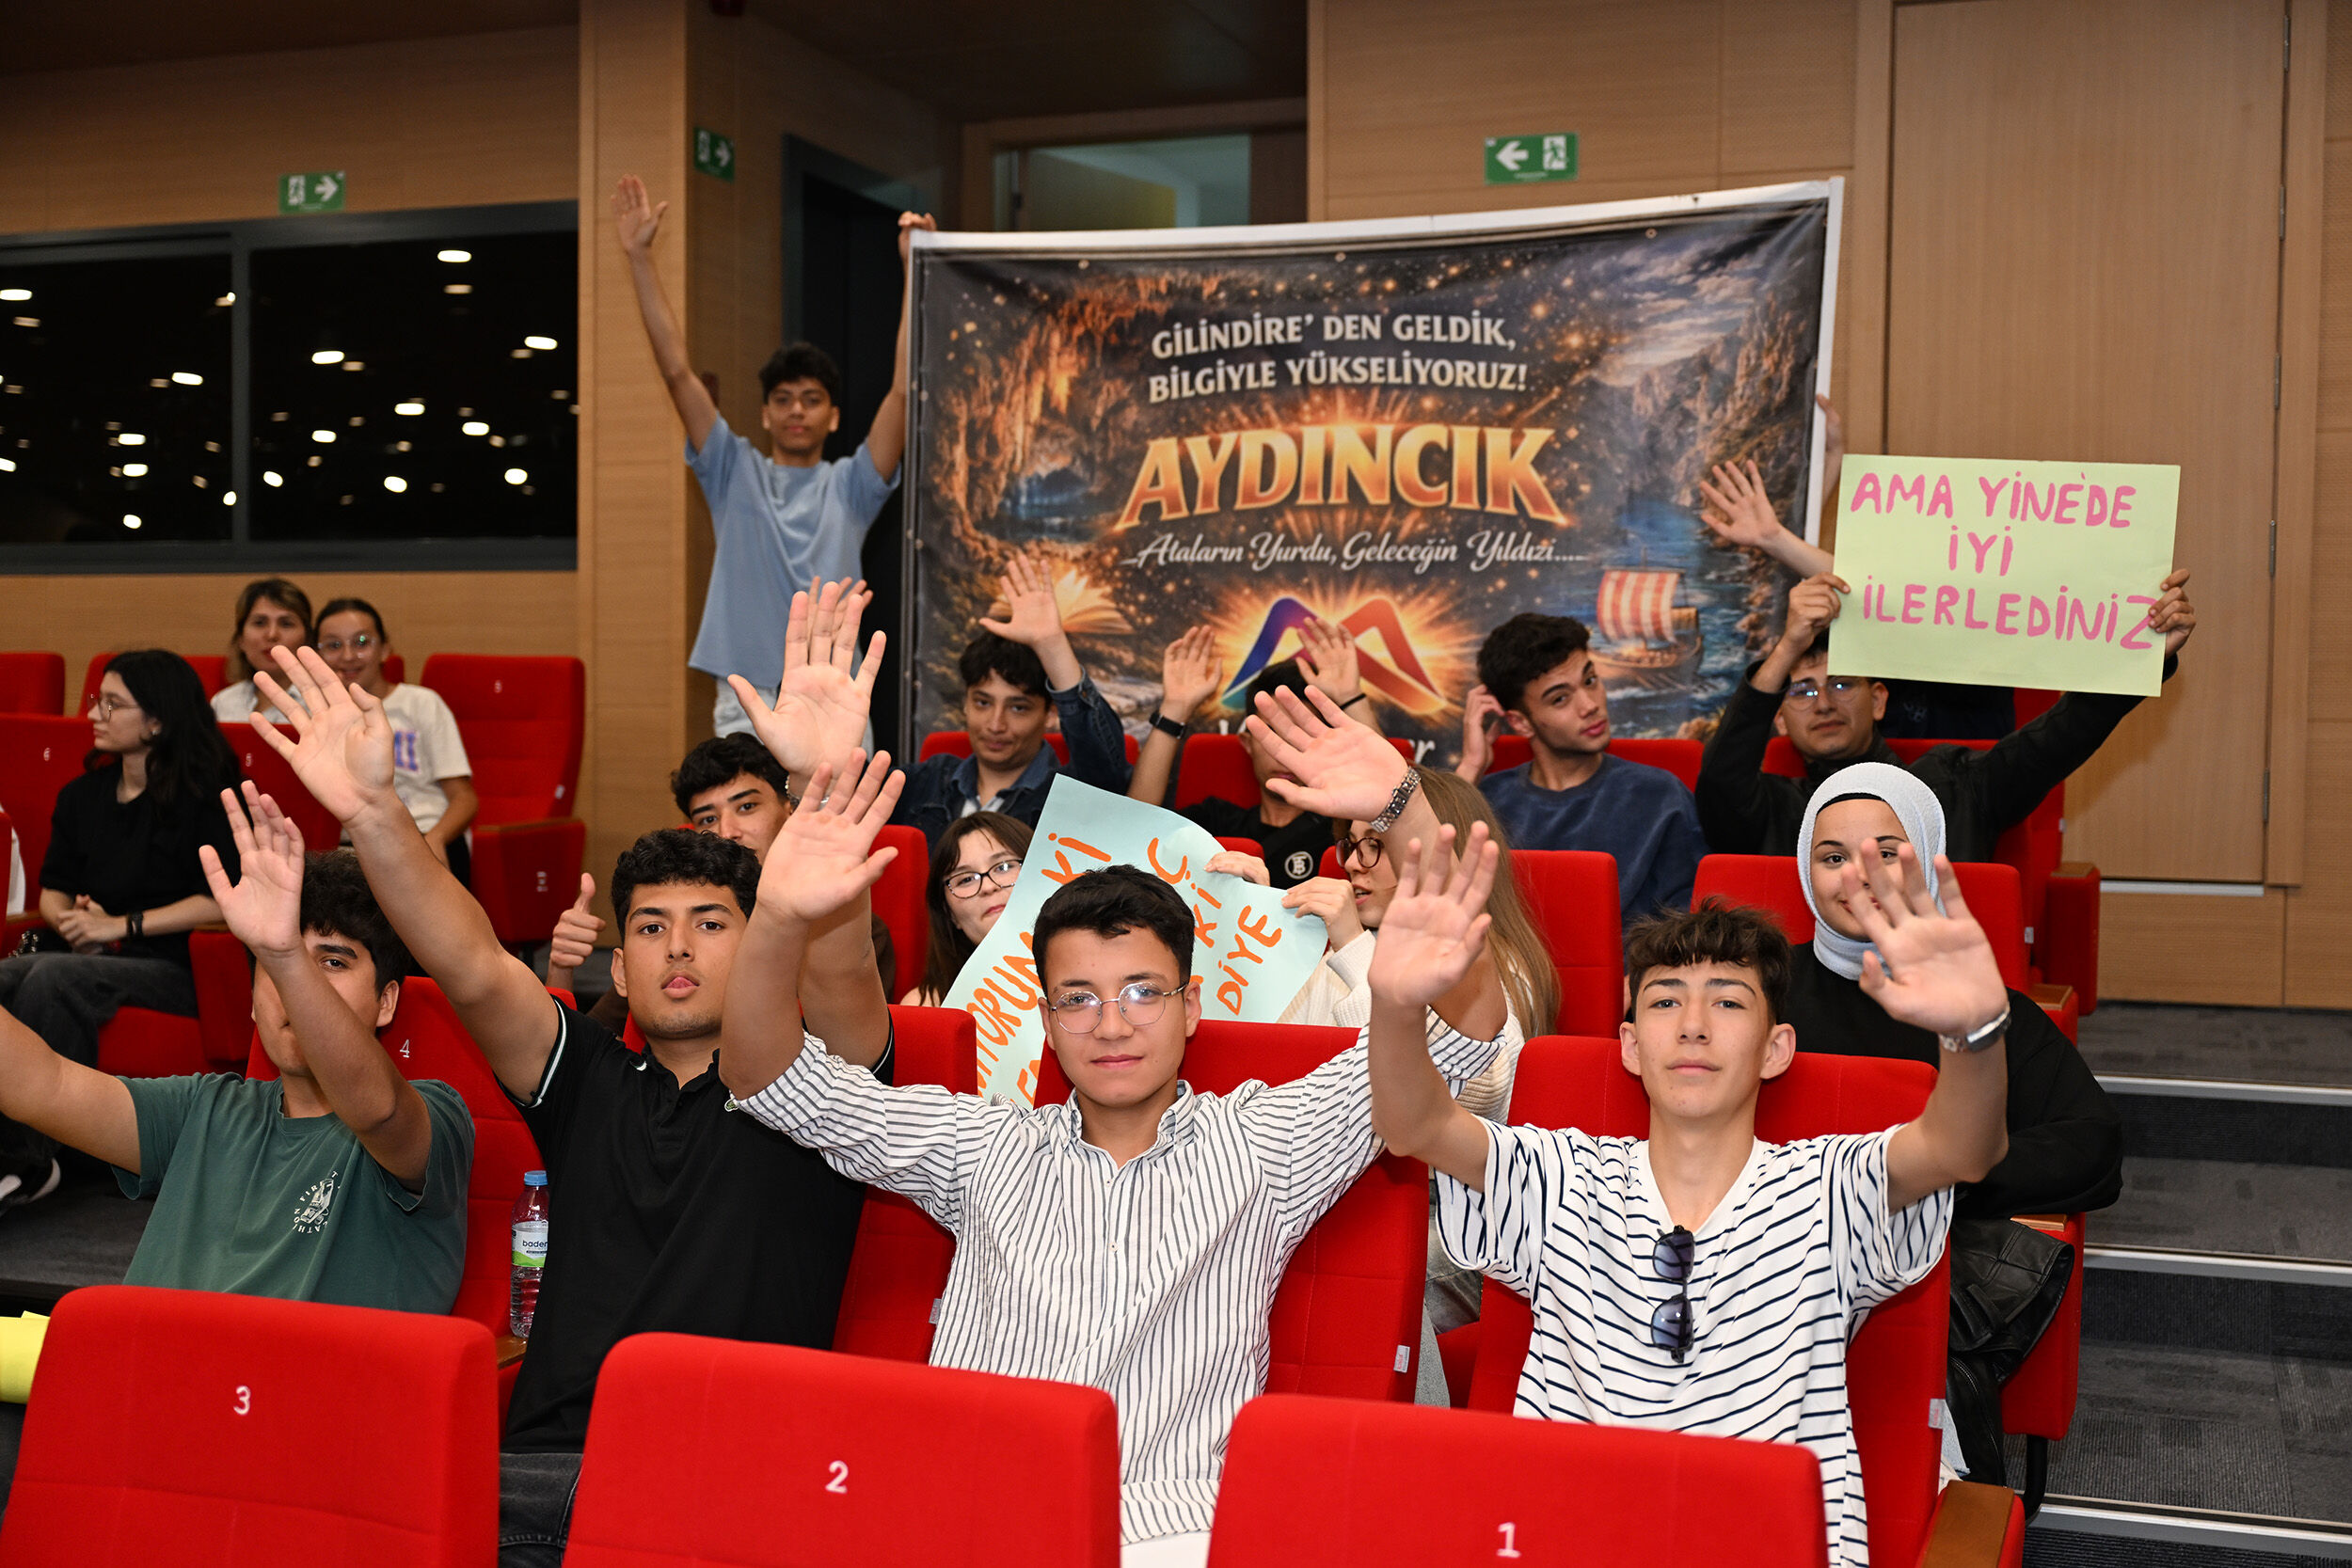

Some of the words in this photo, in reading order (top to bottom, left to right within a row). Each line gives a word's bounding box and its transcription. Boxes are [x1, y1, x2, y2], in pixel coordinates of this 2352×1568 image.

[1323, 314, 1382, 341] DEN
[1392, 309, 1516, 352] GELDİK,
[1149, 358, 1277, 404] BİLGİYLE
[1285, 350, 1528, 391] YÜKSELİYORUZ!
[1113, 422, 1571, 531] AYDINCIK
[1850, 472, 1953, 518] AMA
[1134, 531, 1244, 569] Ataların
[1249, 531, 1338, 572] Yurdu,
[1341, 531, 1459, 575] Geleceğin
[1948, 525, 2013, 577] İYİ
[1863, 575, 2158, 650] İLERLEDİNİZ
[1216, 905, 1282, 1016] DİYE
[400, 1038, 410, 1058] 4
[233, 1386, 251, 1416] 3
[825, 1460, 849, 1494] 2
[1497, 1522, 1522, 1558] 1
